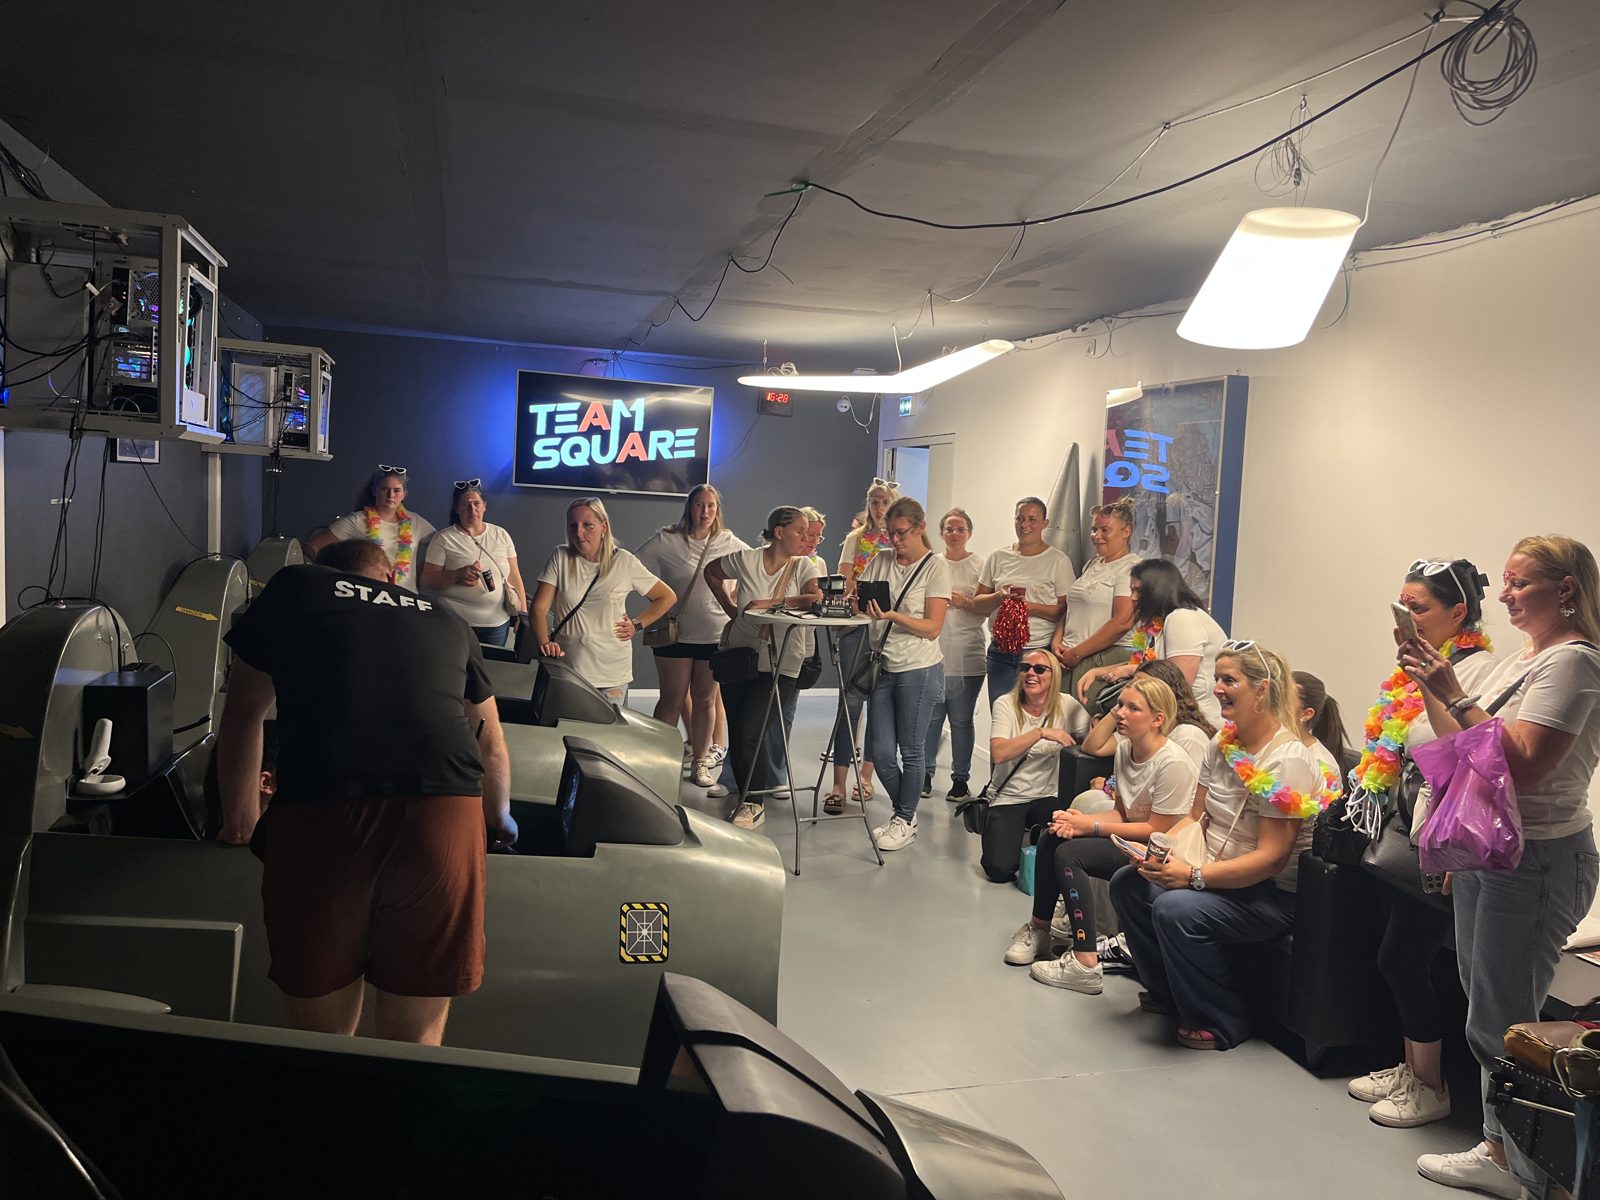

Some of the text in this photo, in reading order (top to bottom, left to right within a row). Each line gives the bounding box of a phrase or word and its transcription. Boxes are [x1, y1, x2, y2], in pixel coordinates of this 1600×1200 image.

[766, 392, 789, 404] 16:28
[529, 398, 645, 436] TEAM
[532, 427, 699, 470] SQUARE
[334, 580, 433, 612] STAFF
